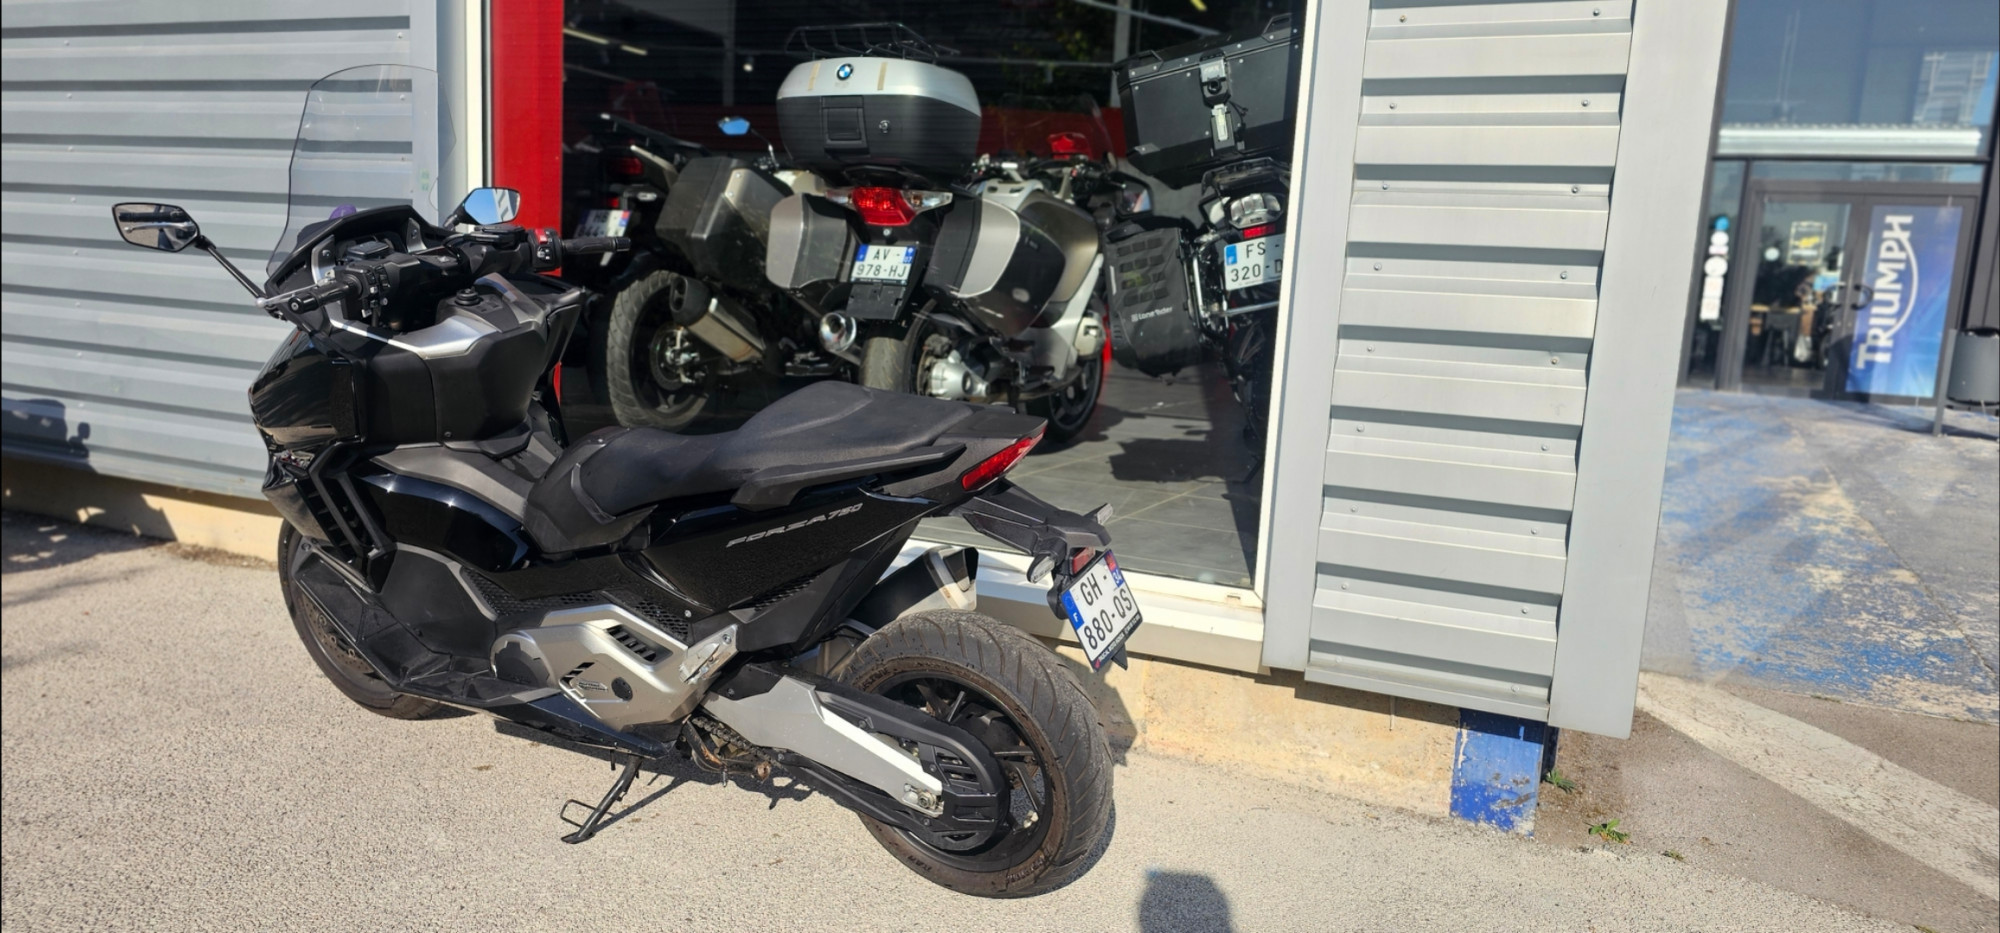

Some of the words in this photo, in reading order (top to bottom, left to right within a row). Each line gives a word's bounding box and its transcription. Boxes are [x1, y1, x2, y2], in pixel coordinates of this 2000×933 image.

[873, 249, 890, 260] AV
[1246, 241, 1266, 259] FS
[856, 264, 907, 277] 978-HJ
[1856, 215, 1918, 369] TRIUMPH
[1080, 573, 1103, 606] GH
[1084, 588, 1132, 650] 880-QS
